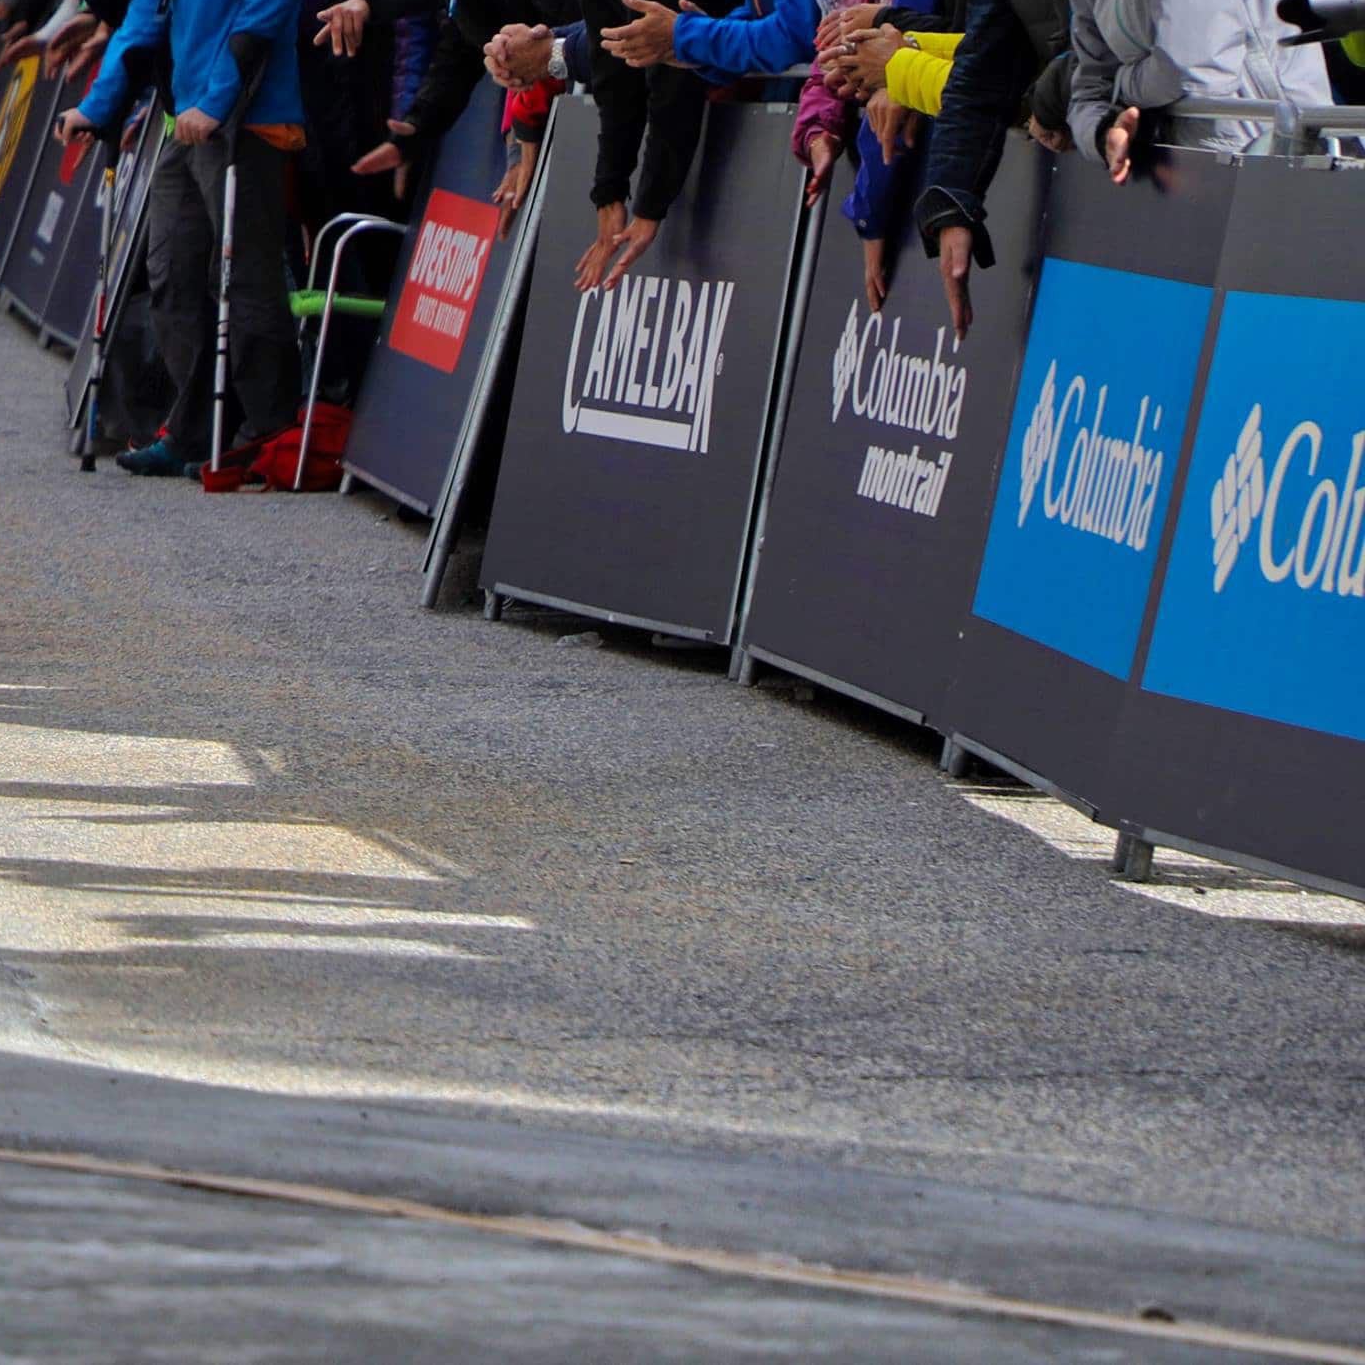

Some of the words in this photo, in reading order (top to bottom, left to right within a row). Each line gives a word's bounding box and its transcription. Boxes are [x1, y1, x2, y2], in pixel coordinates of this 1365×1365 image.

[413, 293, 438, 328] SPORTS
[563, 273, 734, 454] CAMELBAK
[851, 311, 967, 440] Columbia
[856, 444, 954, 518] montrail
[1042, 375, 1164, 552] Columbia
